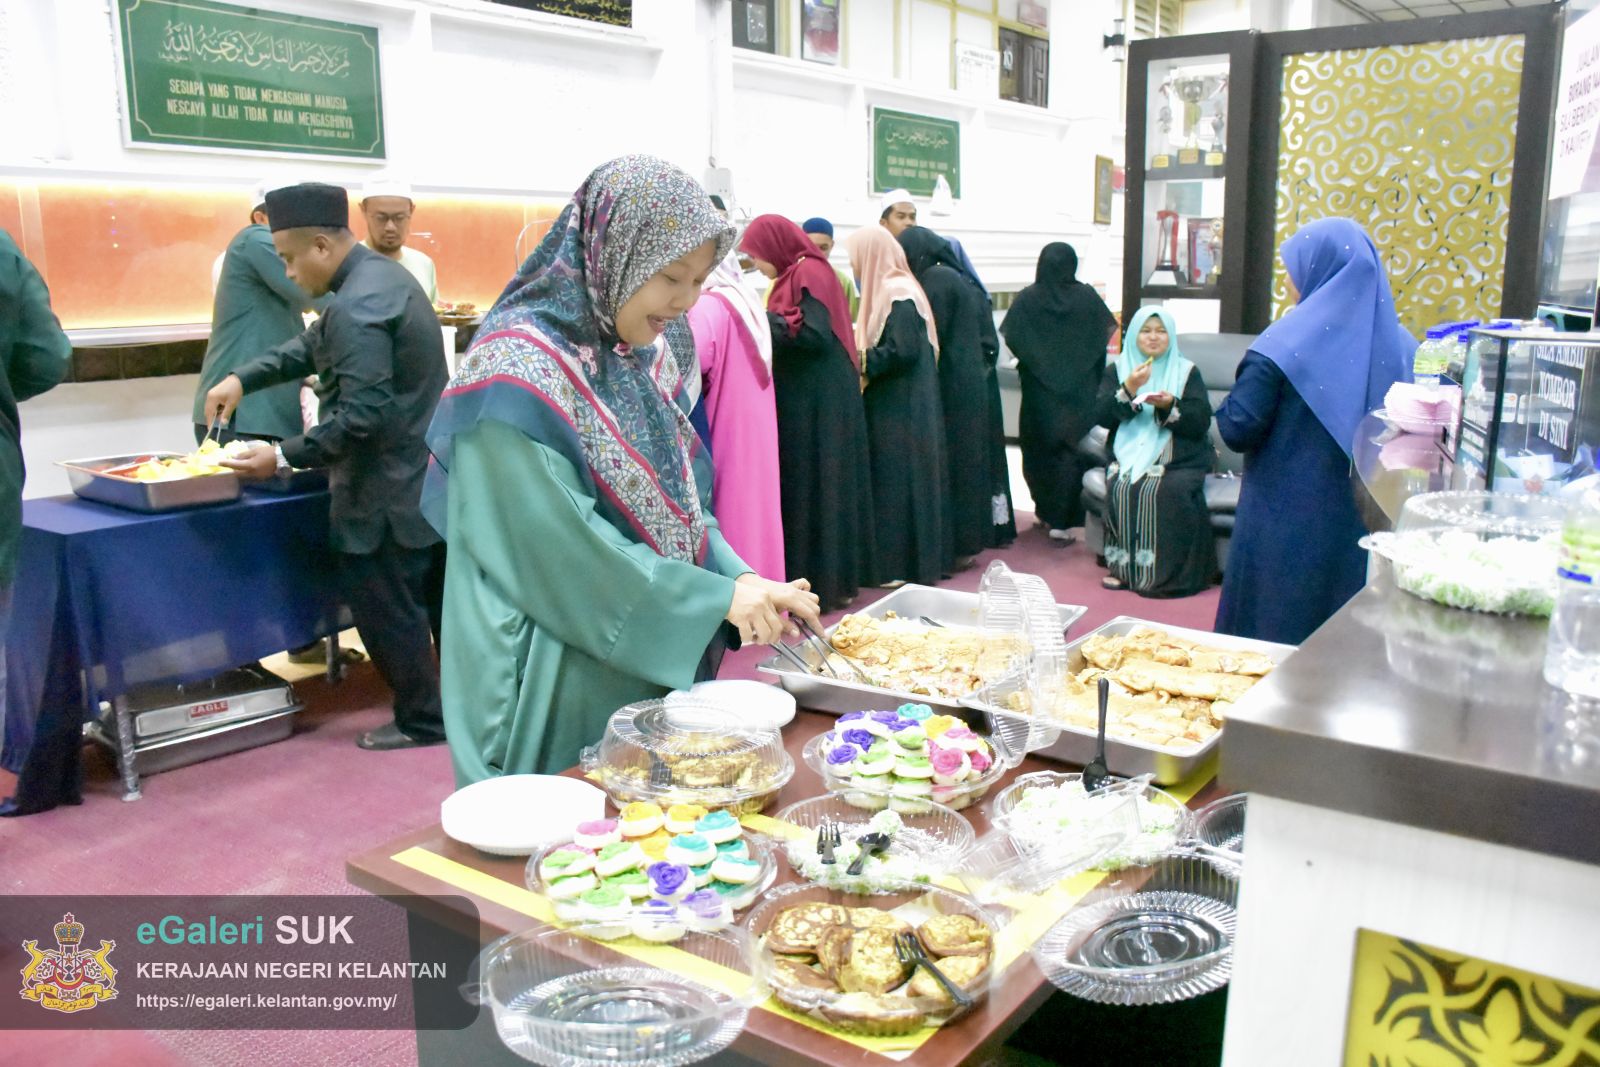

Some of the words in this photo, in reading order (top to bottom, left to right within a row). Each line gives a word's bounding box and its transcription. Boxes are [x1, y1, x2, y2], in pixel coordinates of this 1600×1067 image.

[169, 78, 205, 96] SESIAPA
[207, 82, 229, 99] YANG
[233, 85, 258, 101] TIDAK
[314, 94, 348, 110] MANUSIA
[167, 98, 207, 117] NESCAYA
[212, 103, 239, 120] ALLAH
[243, 106, 268, 122] TIDAK
[274, 109, 295, 125] AKAN
[1538, 370, 1577, 411] NOMBOR
[1538, 408, 1550, 441] DI
[1549, 415, 1569, 451] SINI
[191, 700, 228, 715] EAGLE
